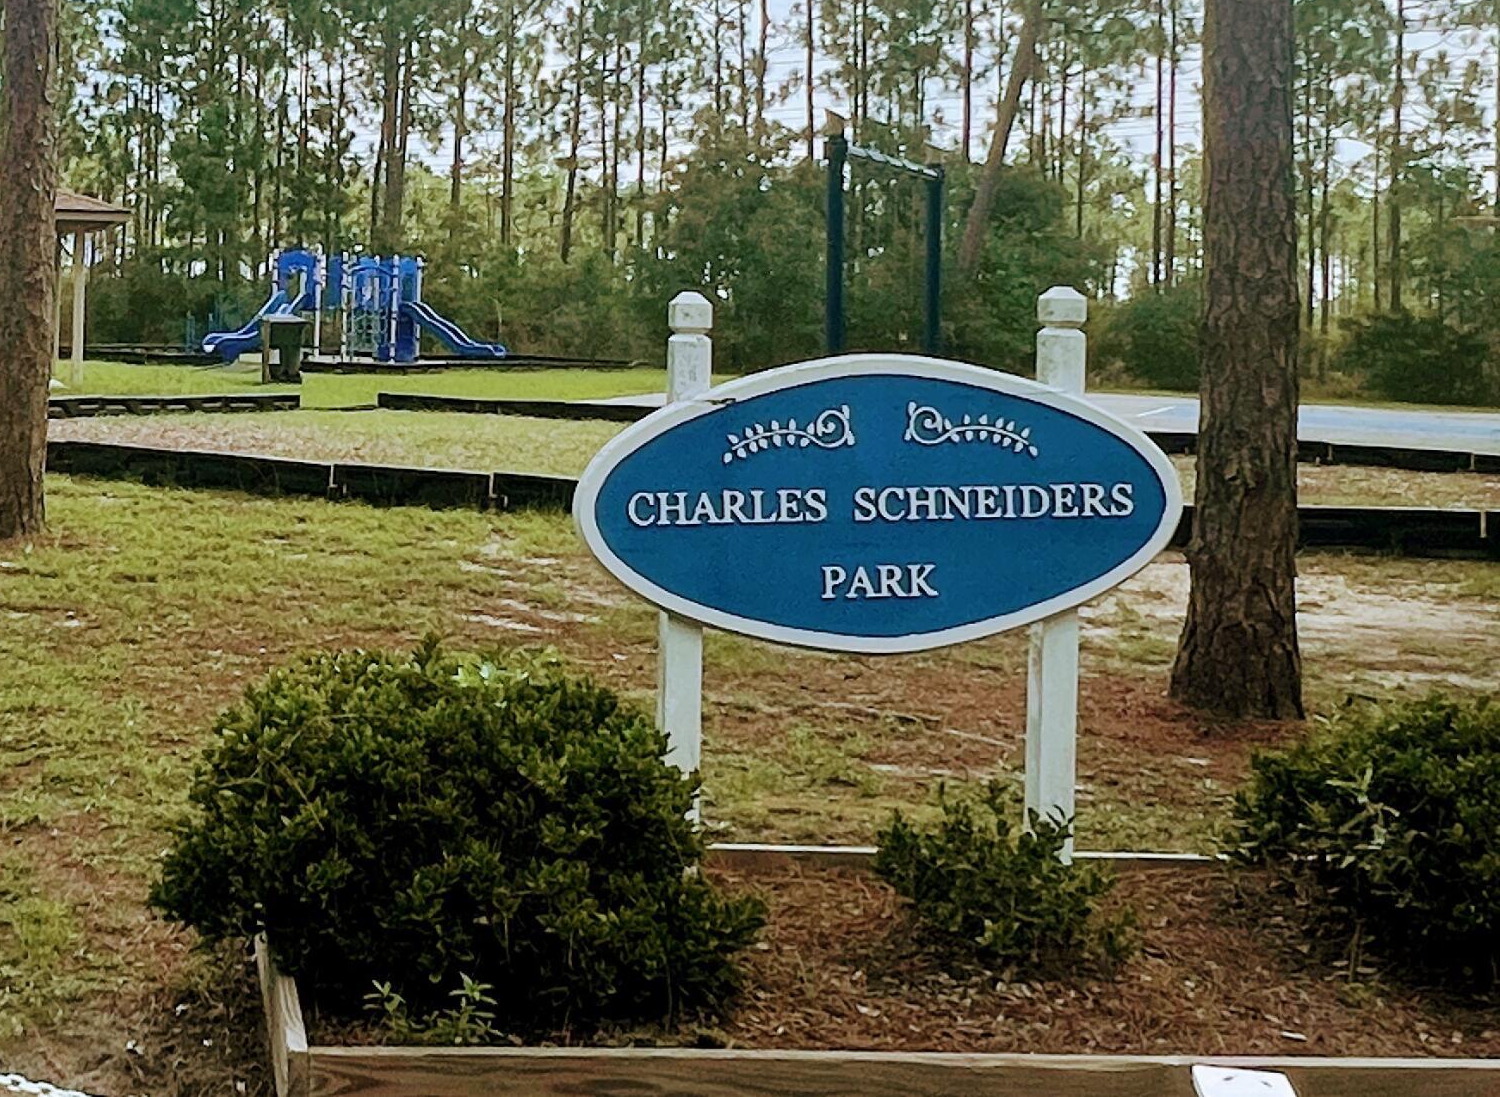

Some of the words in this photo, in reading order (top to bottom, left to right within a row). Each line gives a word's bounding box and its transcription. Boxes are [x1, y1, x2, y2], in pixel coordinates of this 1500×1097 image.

[627, 489, 828, 527] CHARLES
[853, 482, 1134, 523] SCHNEIDERS
[820, 564, 939, 599] PARK
